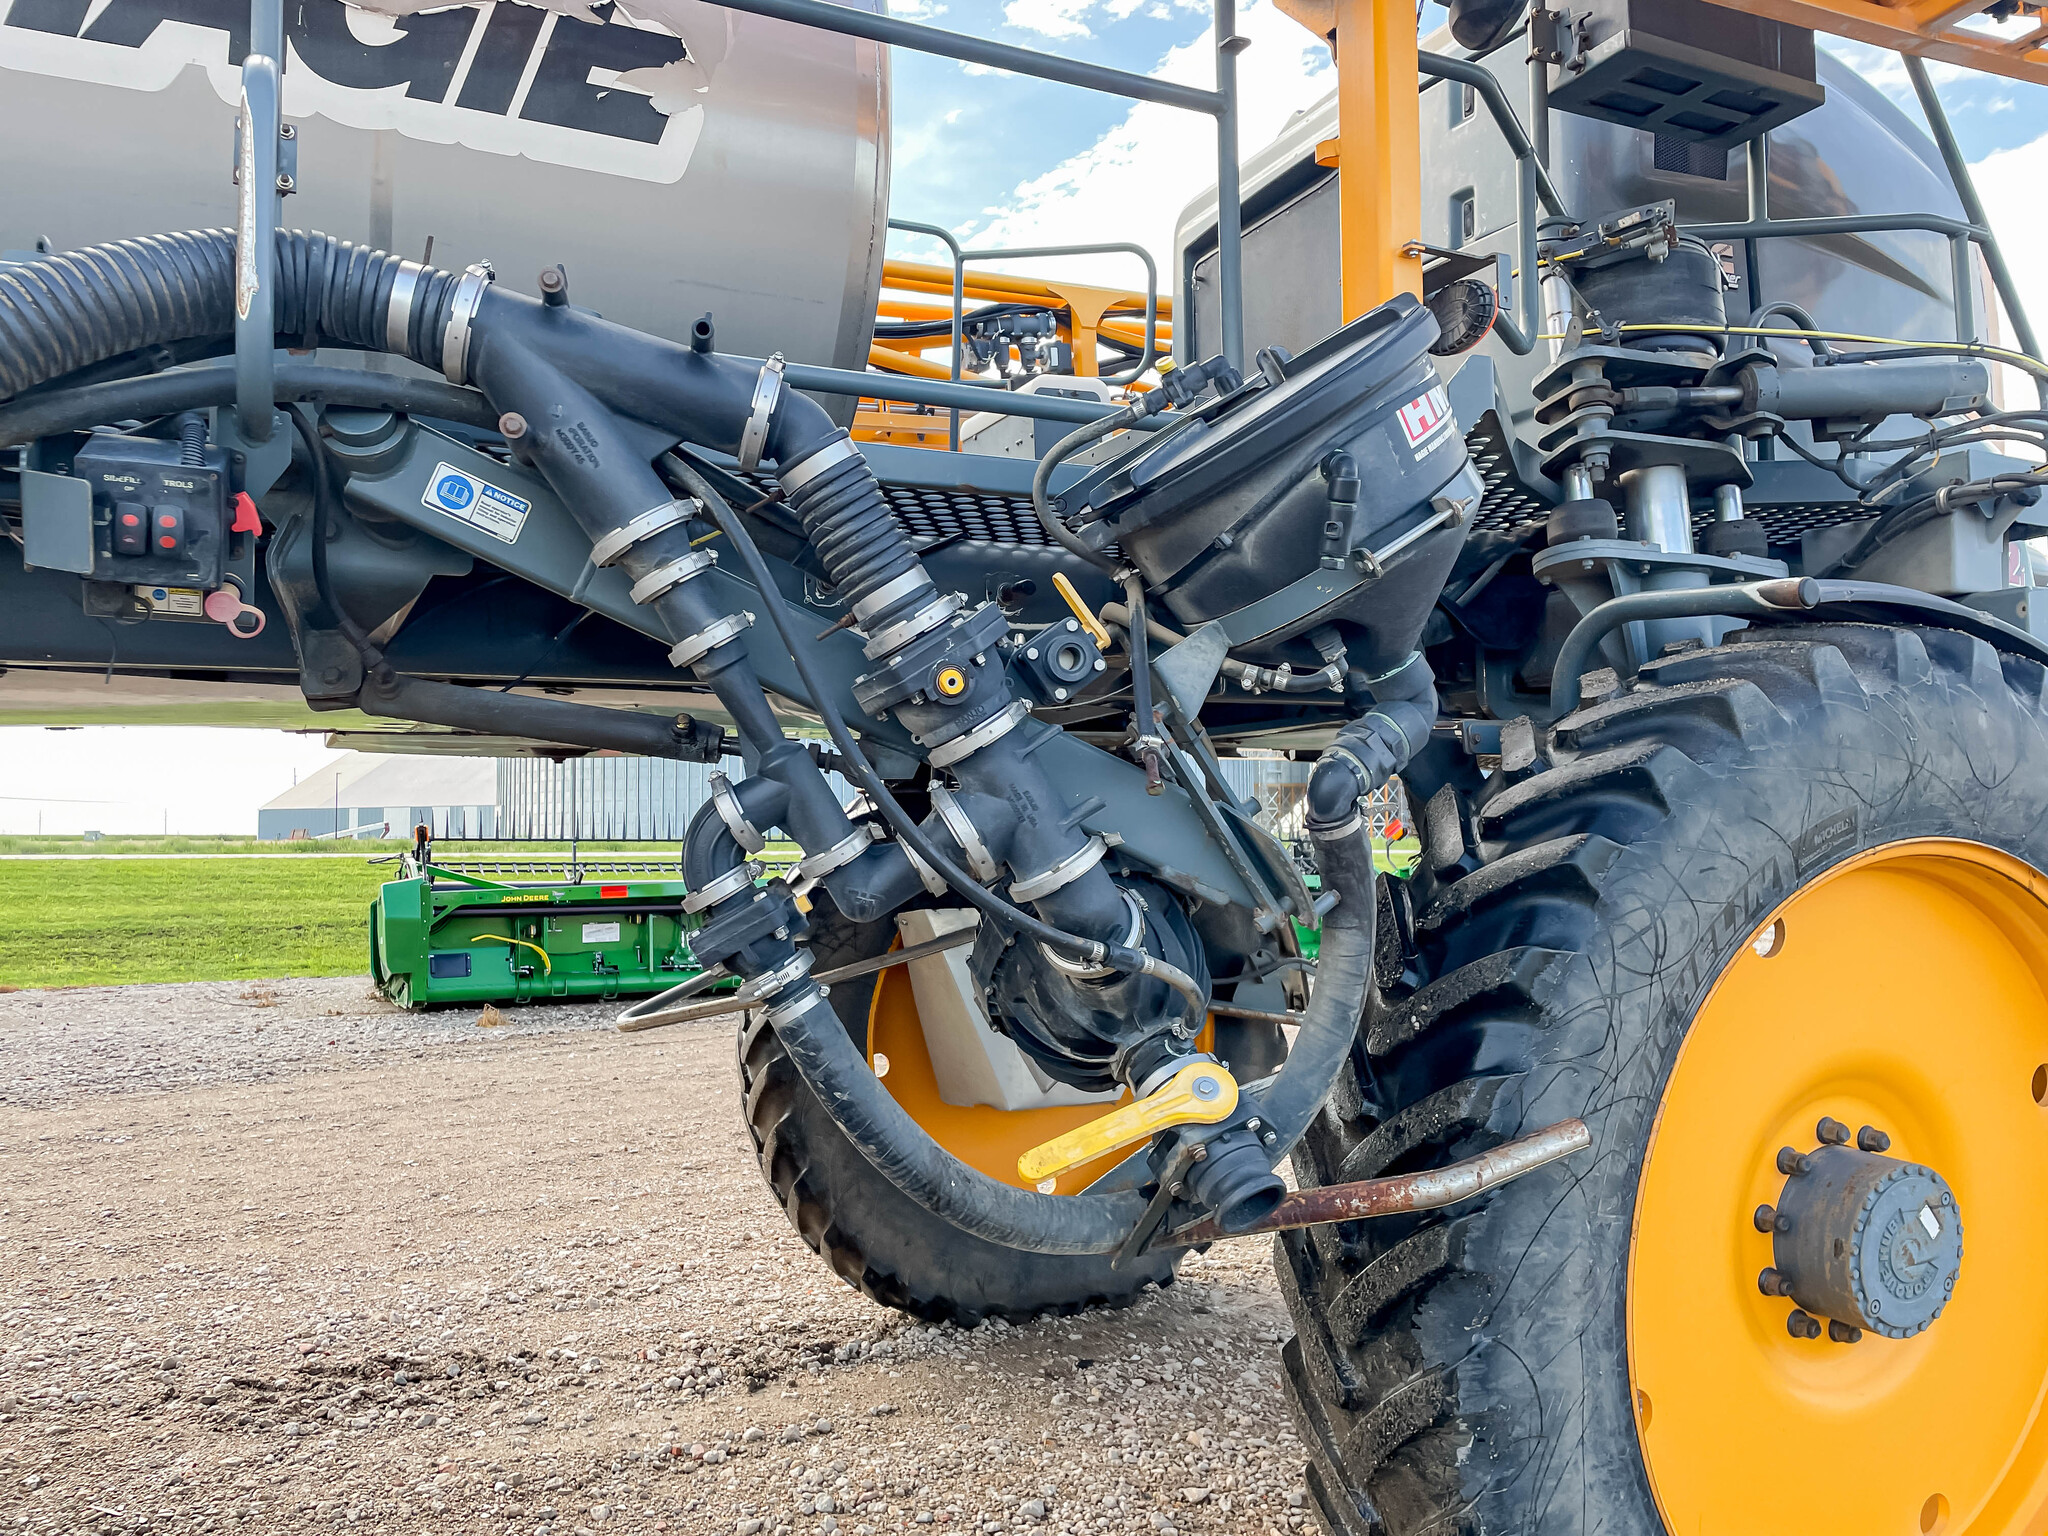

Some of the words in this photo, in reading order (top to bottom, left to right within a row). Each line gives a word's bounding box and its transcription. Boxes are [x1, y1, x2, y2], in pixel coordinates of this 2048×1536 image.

[494, 491, 526, 511] NOTICE
[501, 895, 522, 903] JOHN
[523, 894, 549, 902] DEERE
